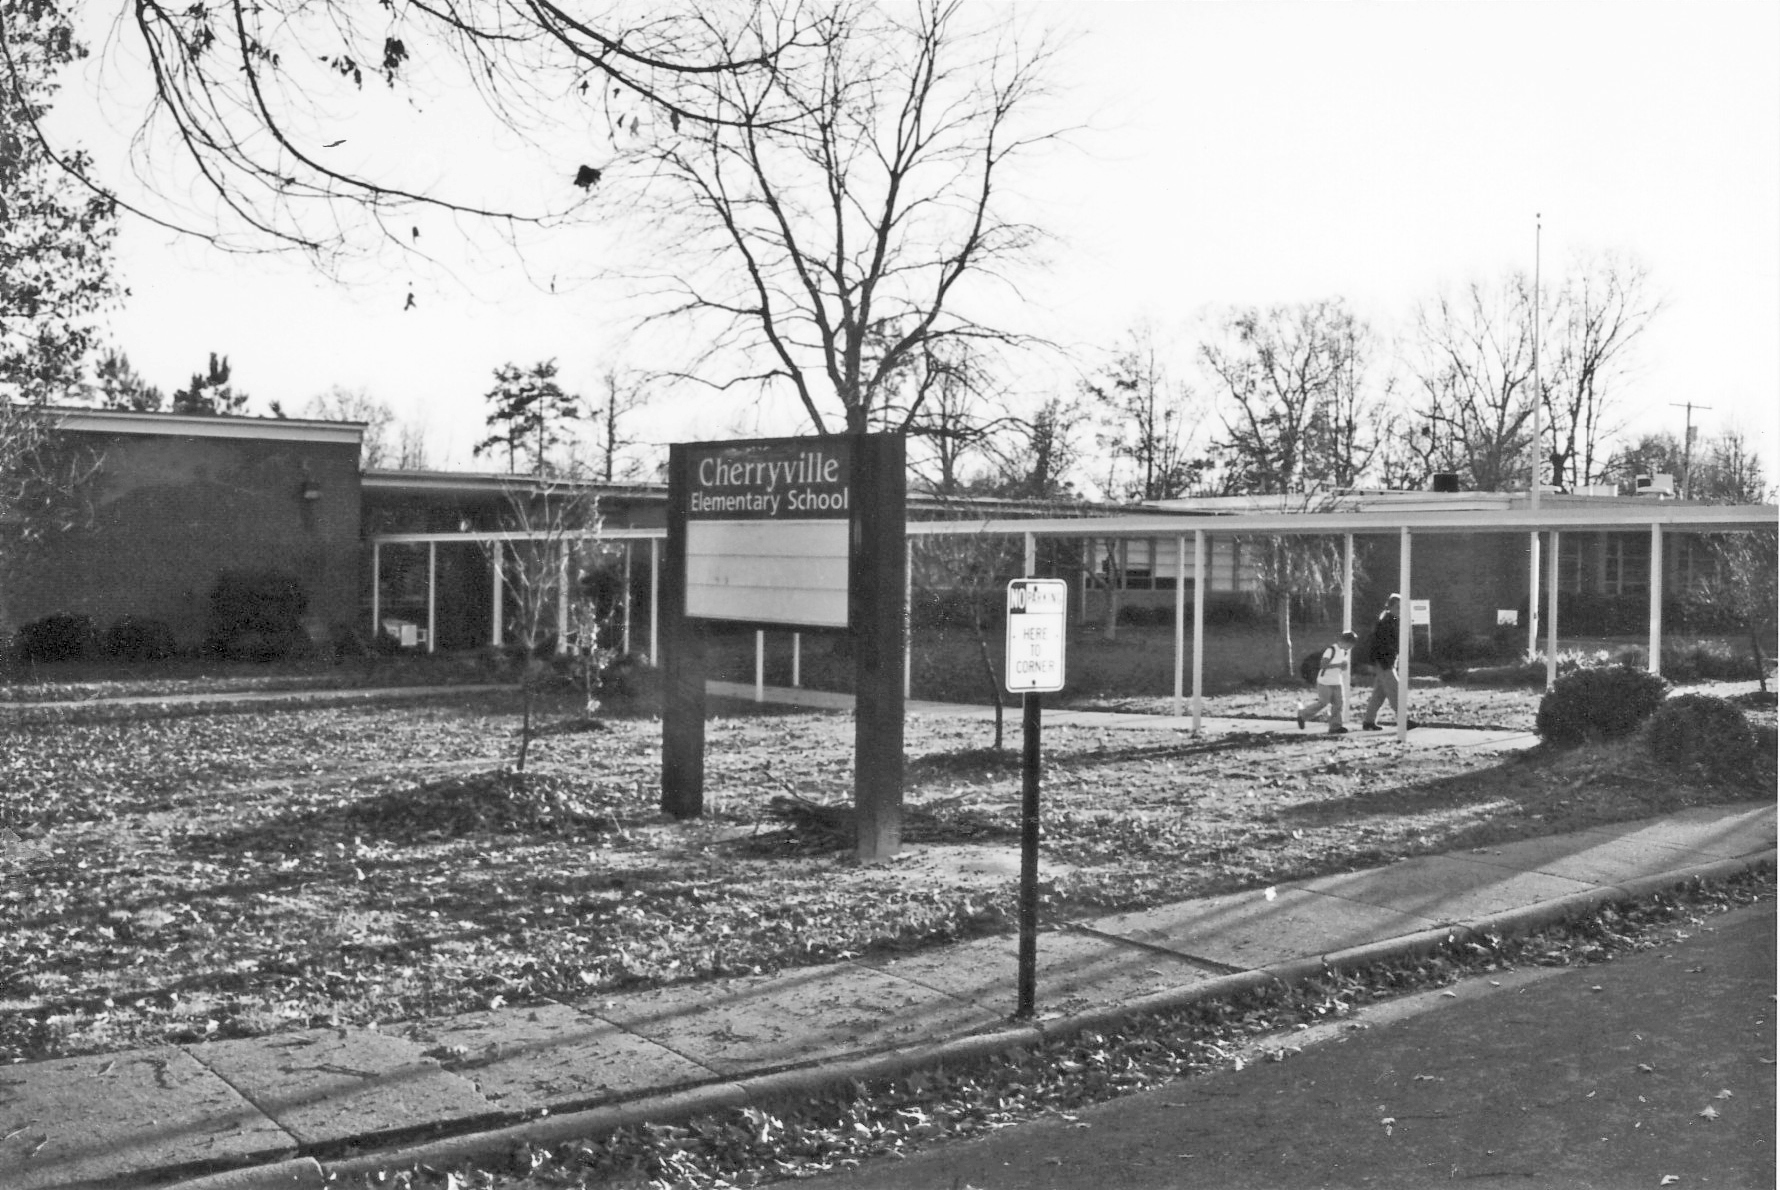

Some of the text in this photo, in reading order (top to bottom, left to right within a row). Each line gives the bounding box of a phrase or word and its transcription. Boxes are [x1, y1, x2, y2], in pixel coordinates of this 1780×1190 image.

[700, 452, 839, 492] Cherryville
[691, 487, 849, 516] Elementary School
[1010, 587, 1026, 609] NO
[1023, 627, 1048, 641] HERE
[1030, 644, 1041, 657] TO
[1016, 660, 1055, 674] CORNER
